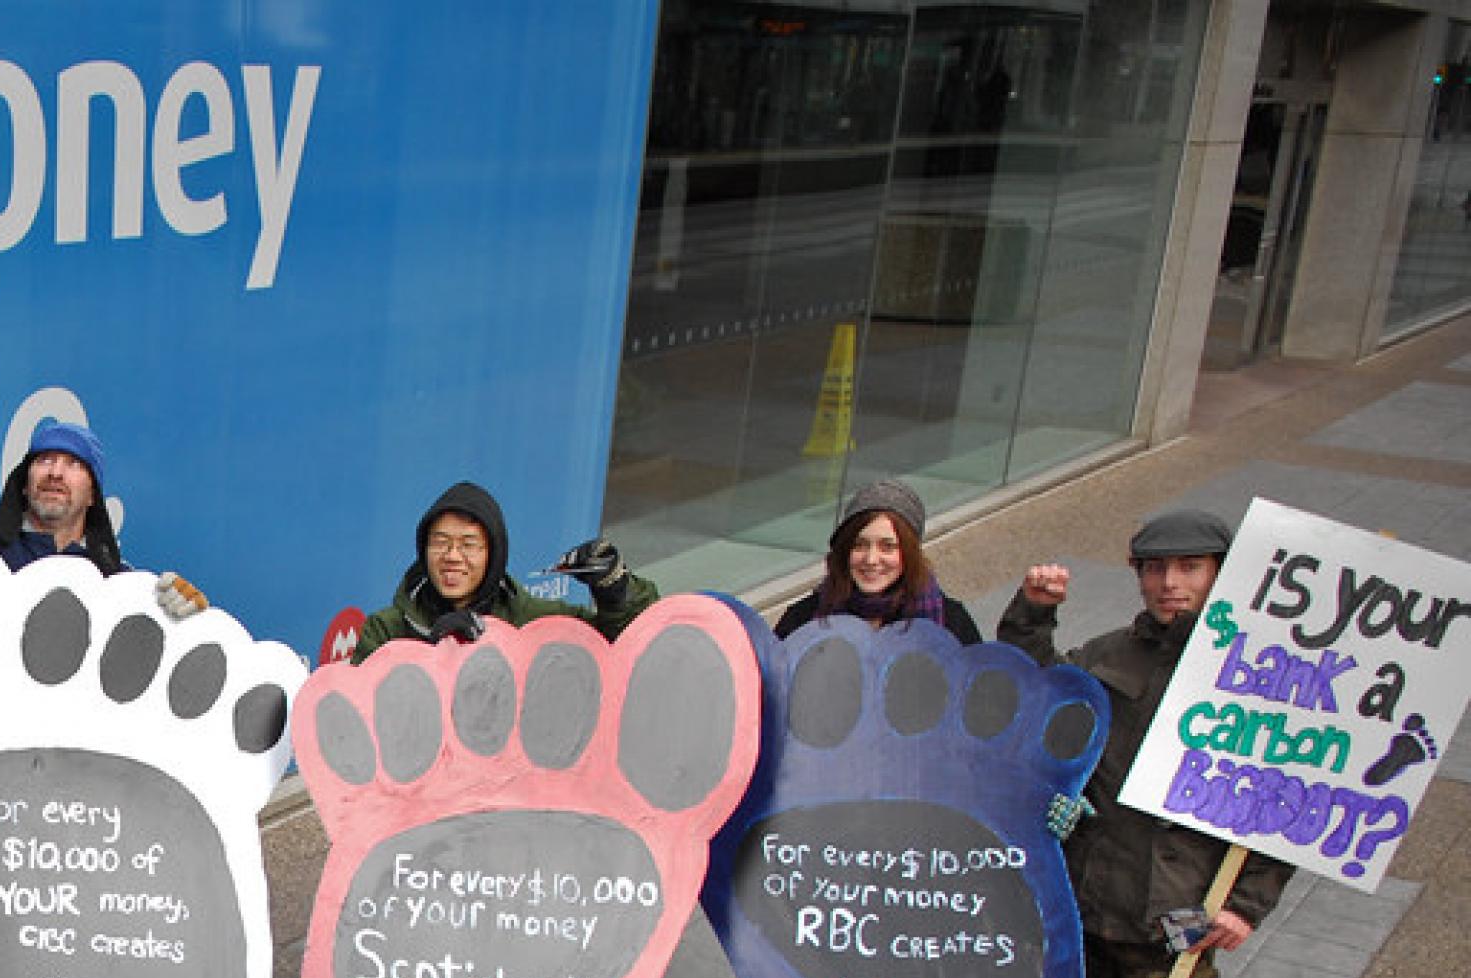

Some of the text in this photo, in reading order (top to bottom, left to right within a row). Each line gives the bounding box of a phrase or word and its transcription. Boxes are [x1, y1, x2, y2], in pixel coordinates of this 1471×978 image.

[1292, 566, 1471, 650] your
[1206, 599, 1405, 722] $ bank a
[1178, 701, 1351, 773] carbon
[42, 800, 122, 843] every
[1, 838, 163, 875] $10,000 of
[392, 853, 659, 906] For every $10,000
[761, 833, 1028, 880] For every $10,000
[358, 896, 597, 950] of your money
[884, 886, 986, 917] money
[19, 925, 185, 964] CIBC creates
[795, 905, 880, 957] RBC
